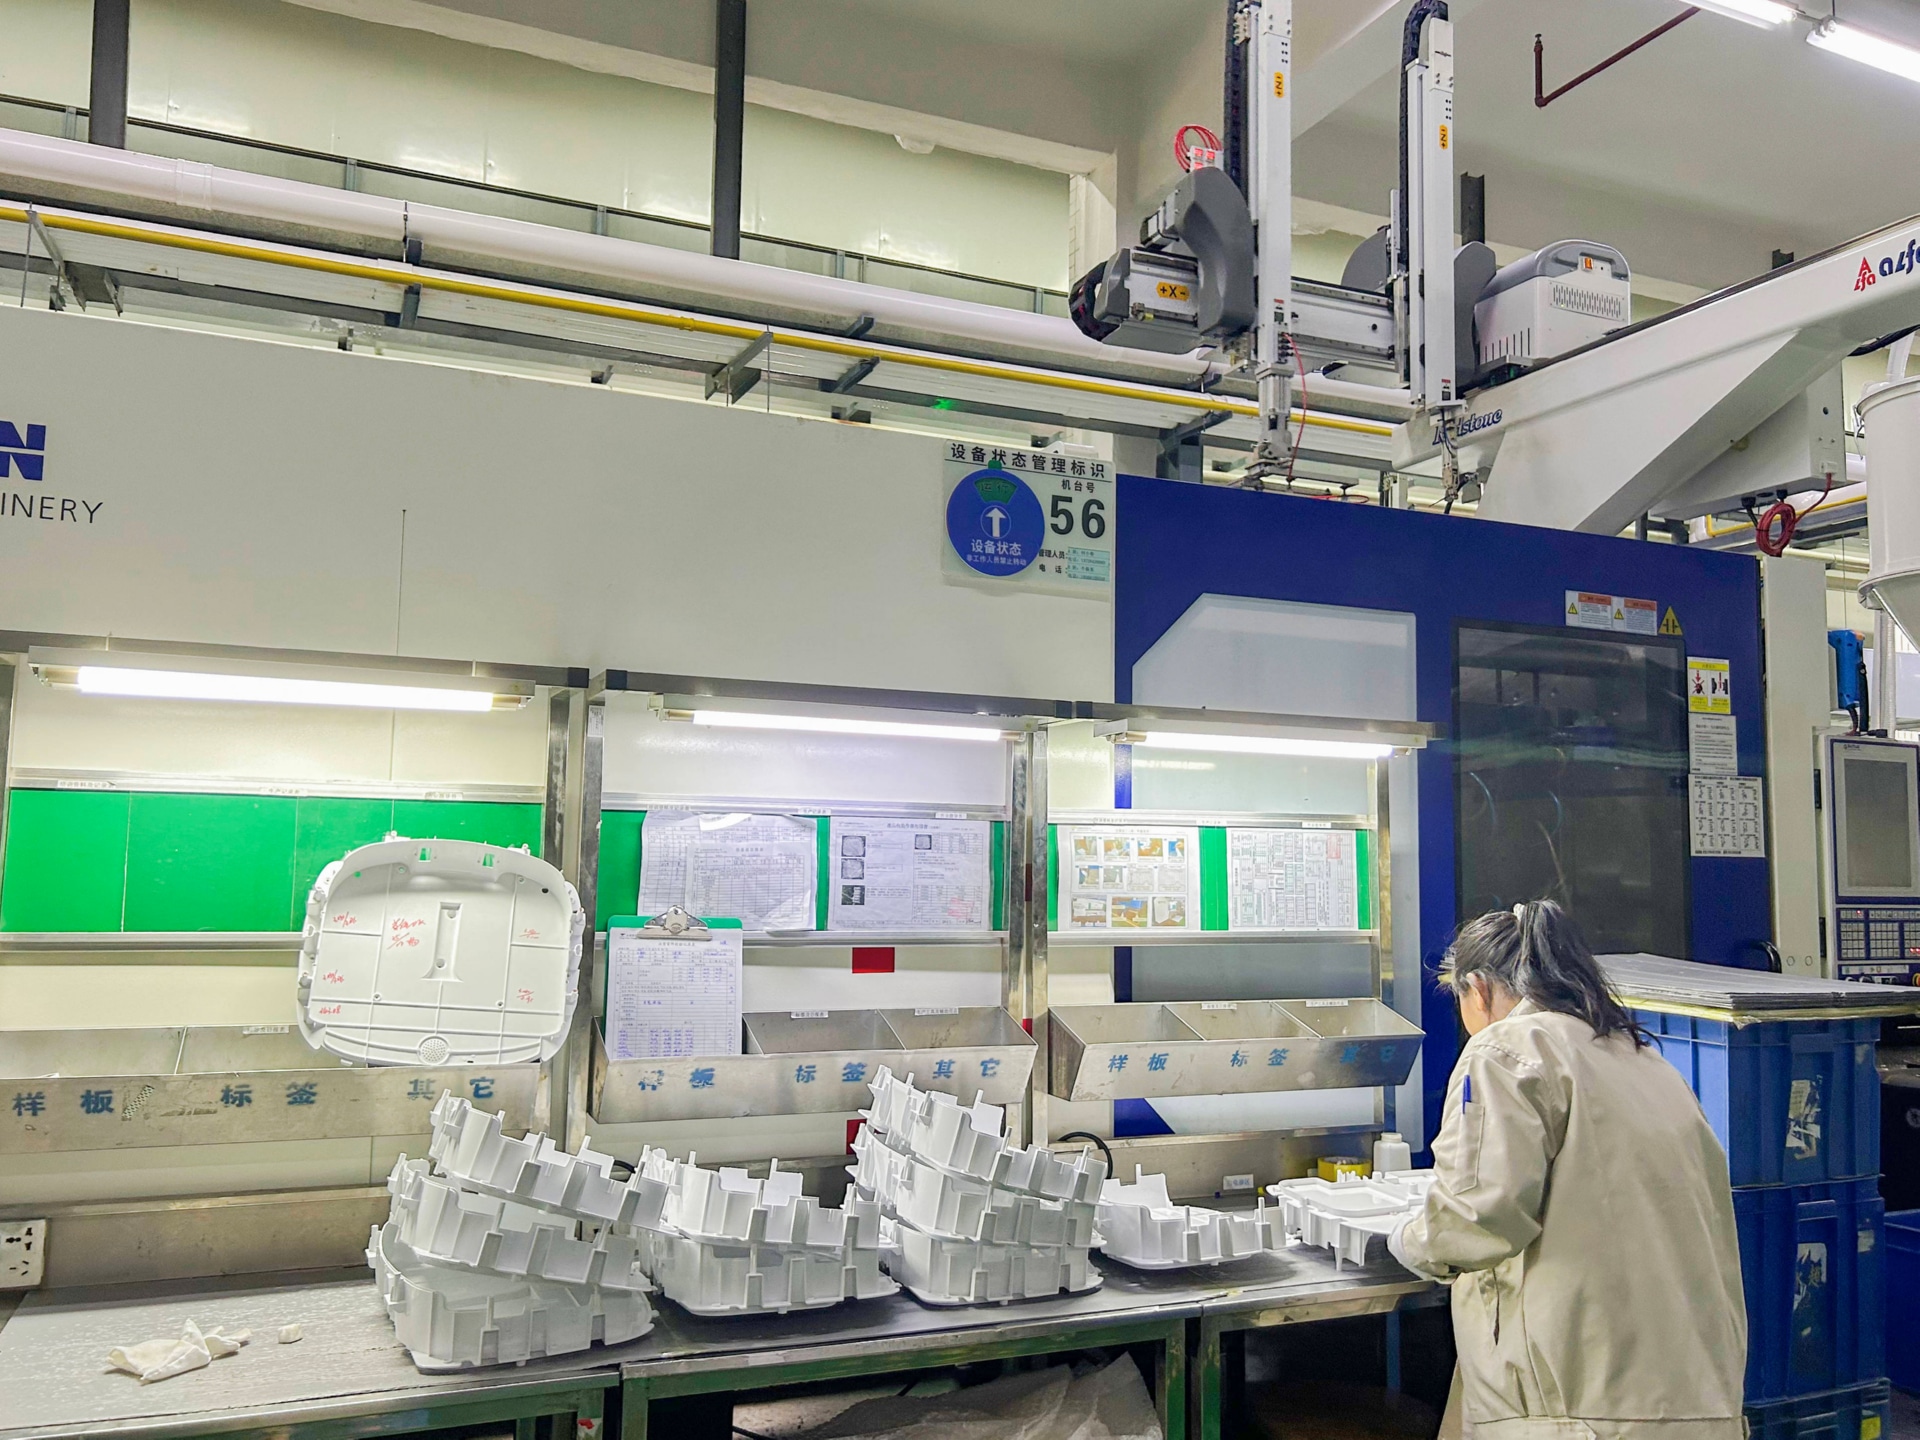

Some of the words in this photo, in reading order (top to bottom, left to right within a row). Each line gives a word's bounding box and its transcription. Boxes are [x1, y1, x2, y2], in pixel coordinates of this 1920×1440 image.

[951, 443, 1106, 479] 设备状态管理标识
[1061, 478, 1096, 495] 机台号
[1050, 494, 1106, 539] 56
[970, 538, 1022, 556] 设备状态
[795, 1063, 868, 1083] 标签
[931, 1058, 1000, 1080] 其它
[1107, 1053, 1170, 1073] 样板
[1229, 1048, 1289, 1068] 标签
[12, 1090, 116, 1117] 样板
[221, 1083, 318, 1107] 标签
[408, 1076, 497, 1101] 其它
